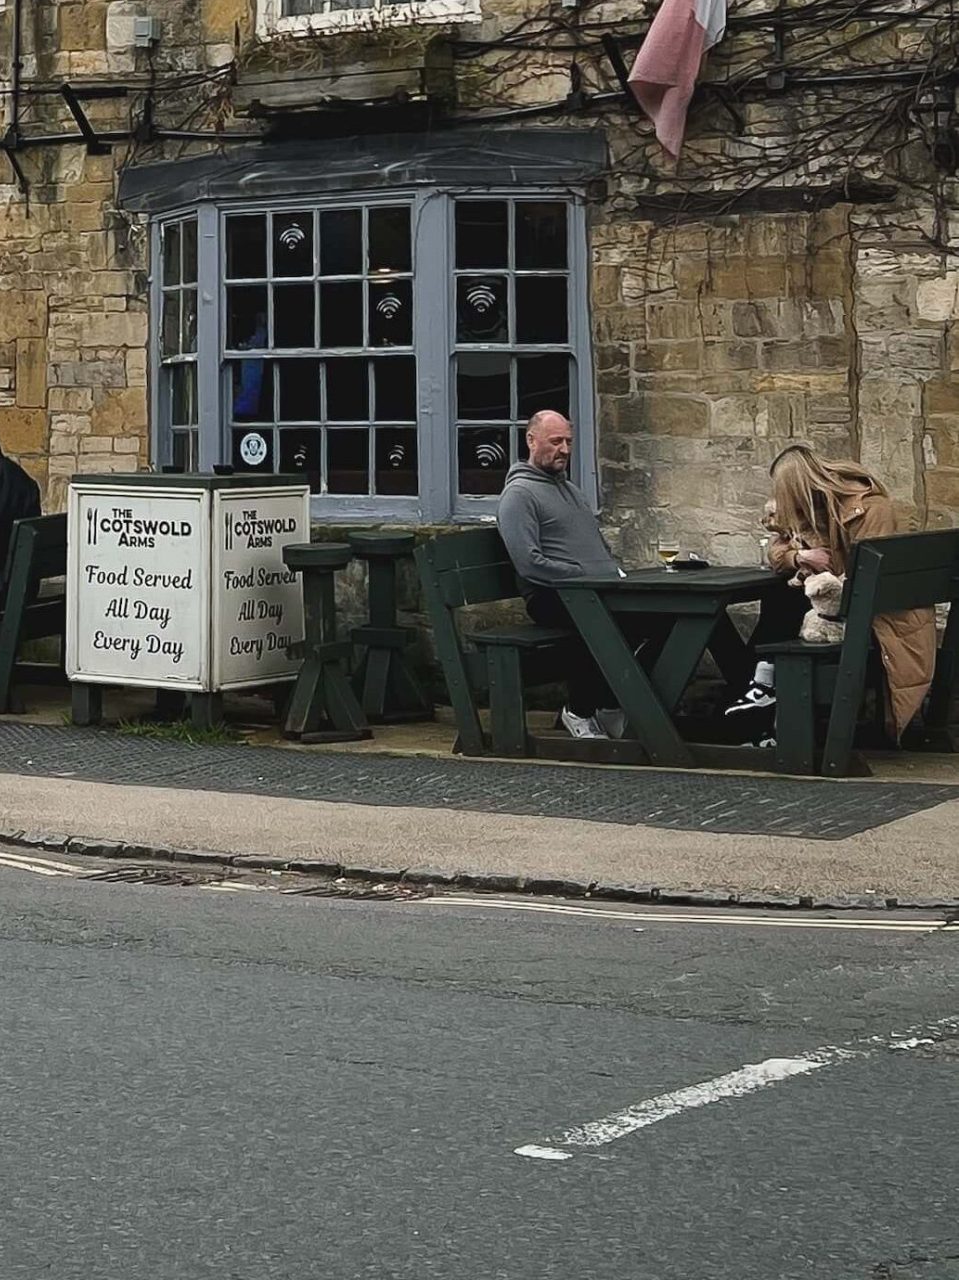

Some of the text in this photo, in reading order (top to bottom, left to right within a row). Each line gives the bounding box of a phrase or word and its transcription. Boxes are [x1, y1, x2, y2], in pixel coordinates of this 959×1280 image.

[112, 508, 133, 519] THE
[242, 510, 257, 521] THE
[100, 518, 192, 537] COTSWOLD
[234, 518, 297, 535] COTSWOLD
[118, 533, 155, 549] ARMS
[247, 534, 272, 550] ARMS
[85, 564, 193, 590] Food Served
[224, 567, 297, 590] Food Served
[104, 597, 171, 629] All Day
[238, 600, 283, 625] All Day
[93, 630, 184, 663] Every Day
[230, 636, 263, 661] Every
